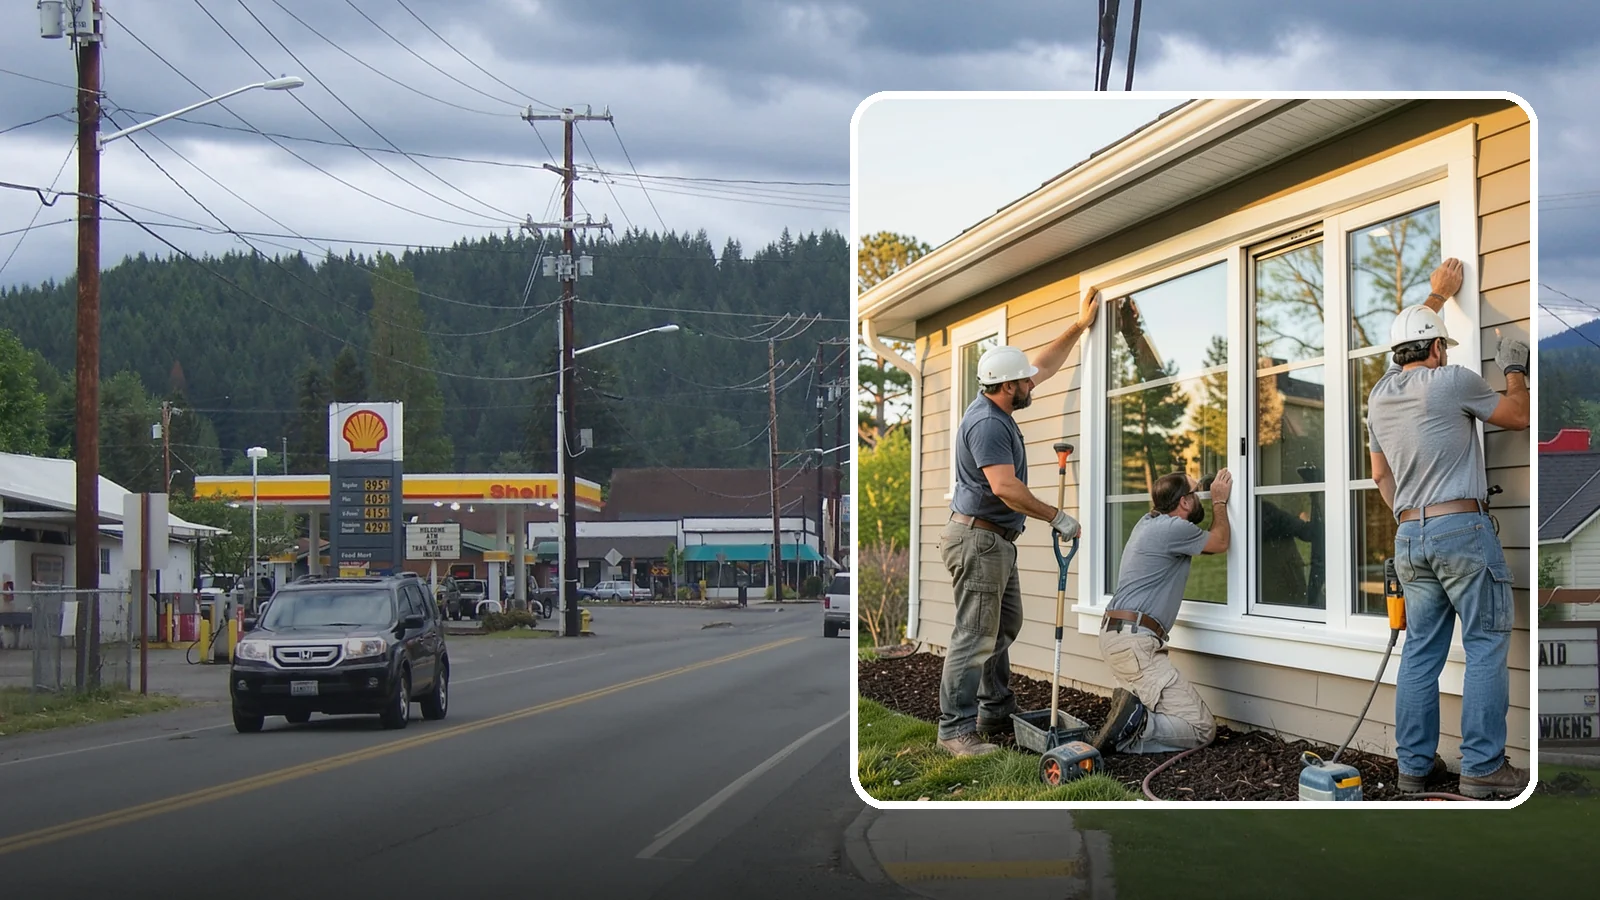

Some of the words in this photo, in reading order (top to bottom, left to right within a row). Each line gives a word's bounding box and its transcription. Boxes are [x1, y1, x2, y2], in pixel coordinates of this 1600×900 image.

[365, 480, 383, 490] 395
[490, 484, 547, 499] Shell
[365, 494, 383, 504] 405
[365, 508, 383, 518] 415
[365, 522, 383, 532] 429
[1539, 642, 1567, 665] AID
